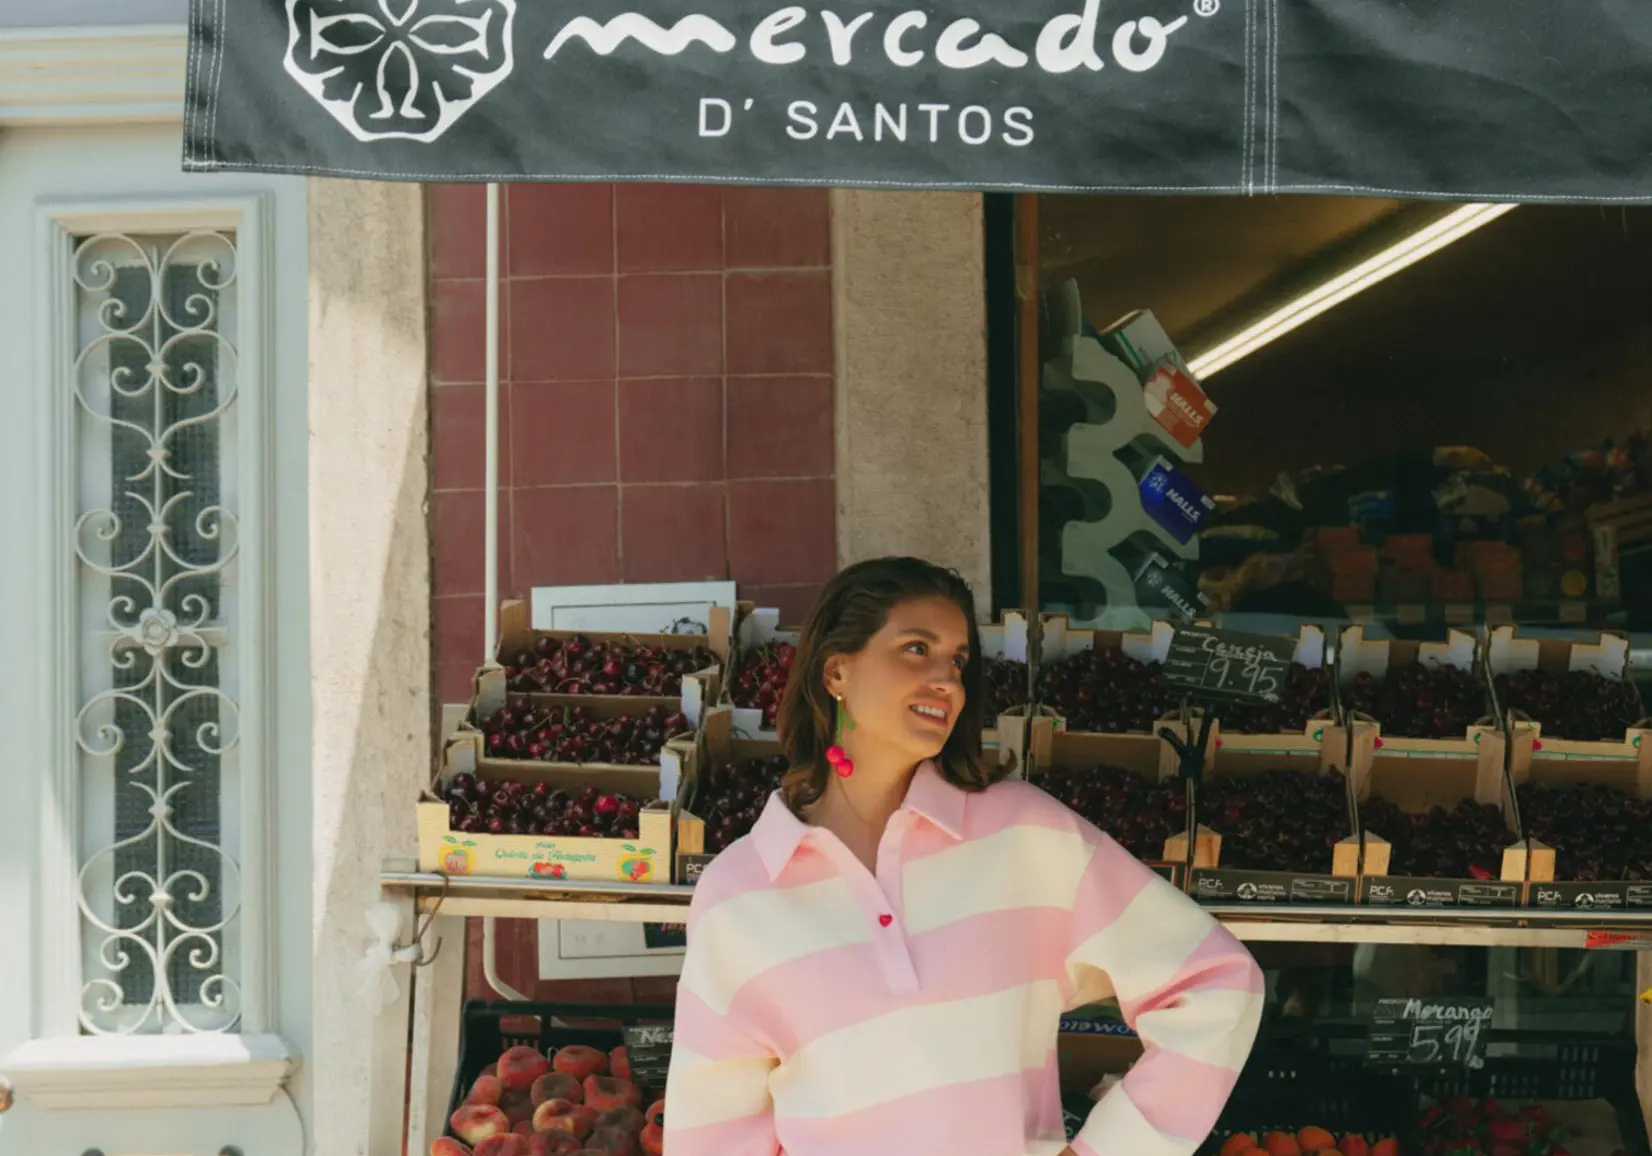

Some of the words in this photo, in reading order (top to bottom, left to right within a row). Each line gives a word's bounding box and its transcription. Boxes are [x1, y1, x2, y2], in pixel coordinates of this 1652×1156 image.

[543, 0, 1188, 73] mercado
[785, 100, 1035, 147] SANTOS
[1169, 391, 1205, 426] HALLS
[1165, 487, 1201, 524] HALLS
[1160, 584, 1197, 620] HALLS
[1208, 657, 1284, 693] 9.95
[1402, 998, 1494, 1020] Morango
[1408, 1018, 1482, 1064] 5.99
